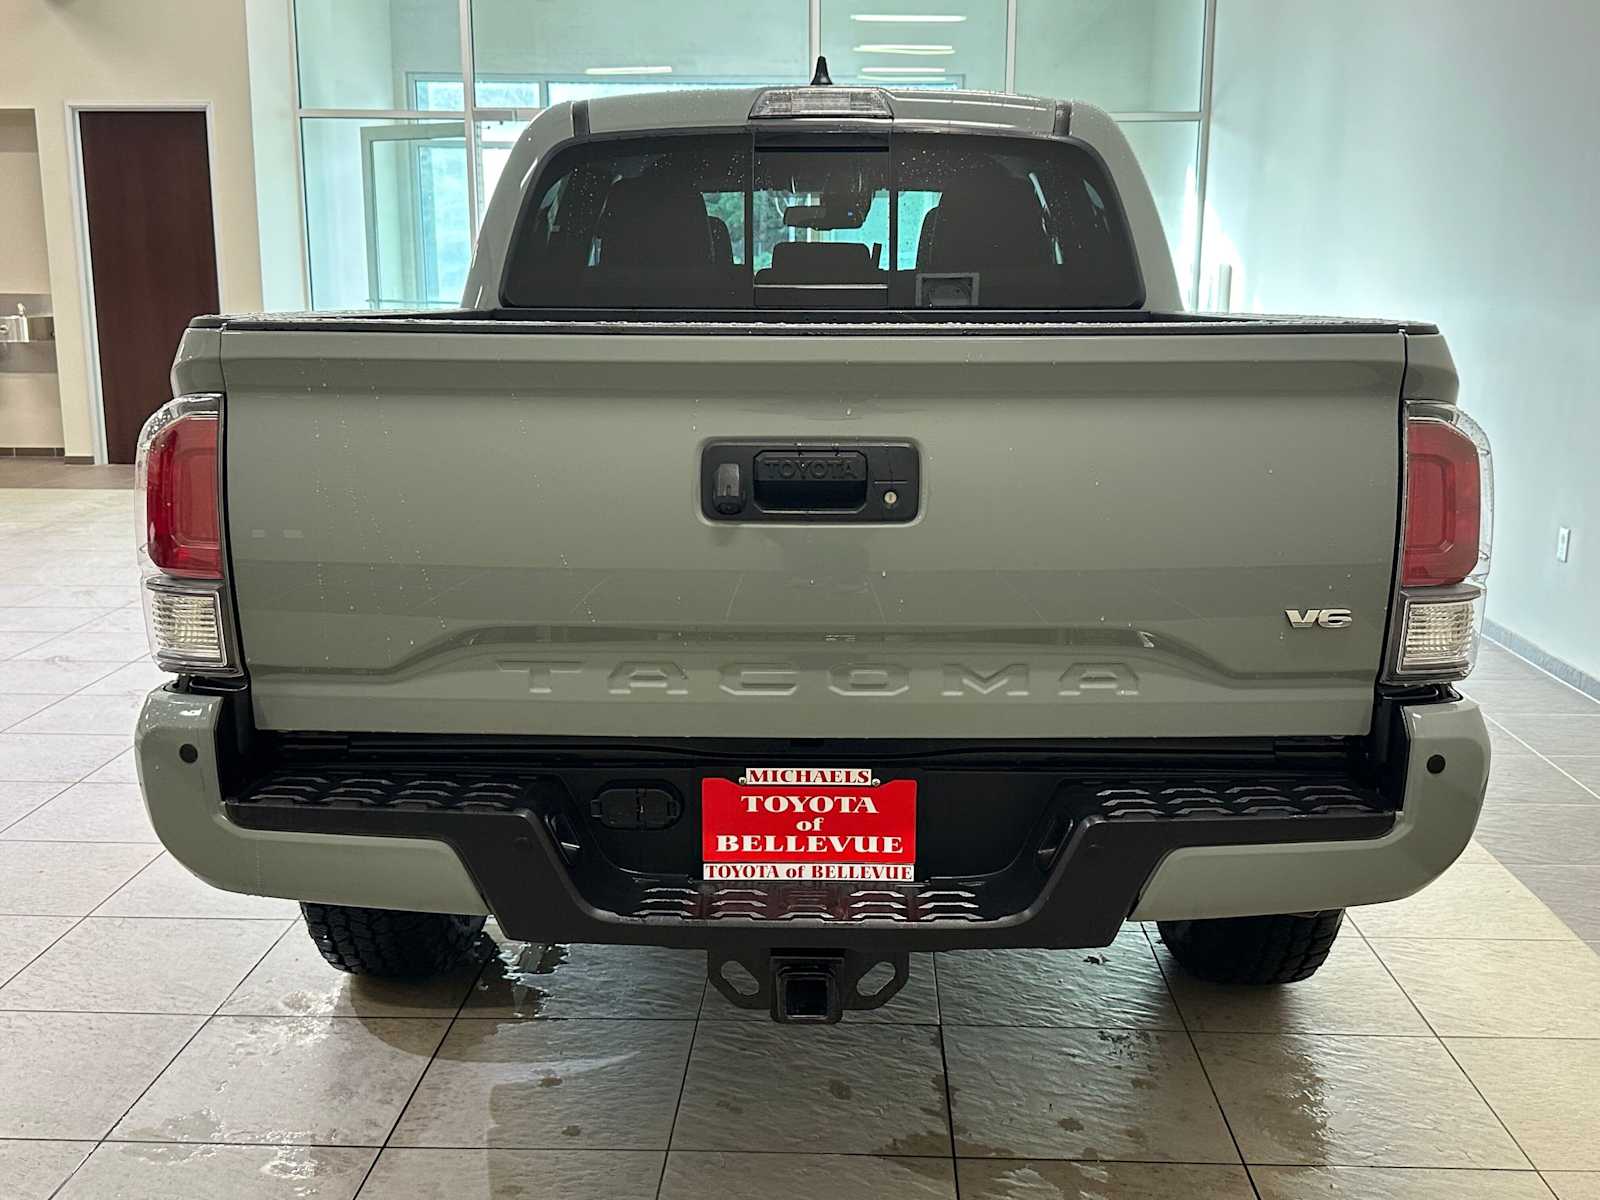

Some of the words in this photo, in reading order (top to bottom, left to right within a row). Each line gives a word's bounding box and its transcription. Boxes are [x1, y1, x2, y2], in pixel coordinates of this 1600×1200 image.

[764, 459, 858, 480] TOYOTA
[1284, 608, 1353, 628] V6
[496, 659, 1140, 697] TACOMA
[749, 769, 870, 784] MICHAELS
[740, 795, 880, 814] TOYOTA
[795, 817, 825, 832] of
[715, 834, 904, 854] BELLEVUE
[705, 865, 779, 879] TOYOTA
[785, 864, 807, 879] of
[811, 865, 913, 880] BELLEVUE
